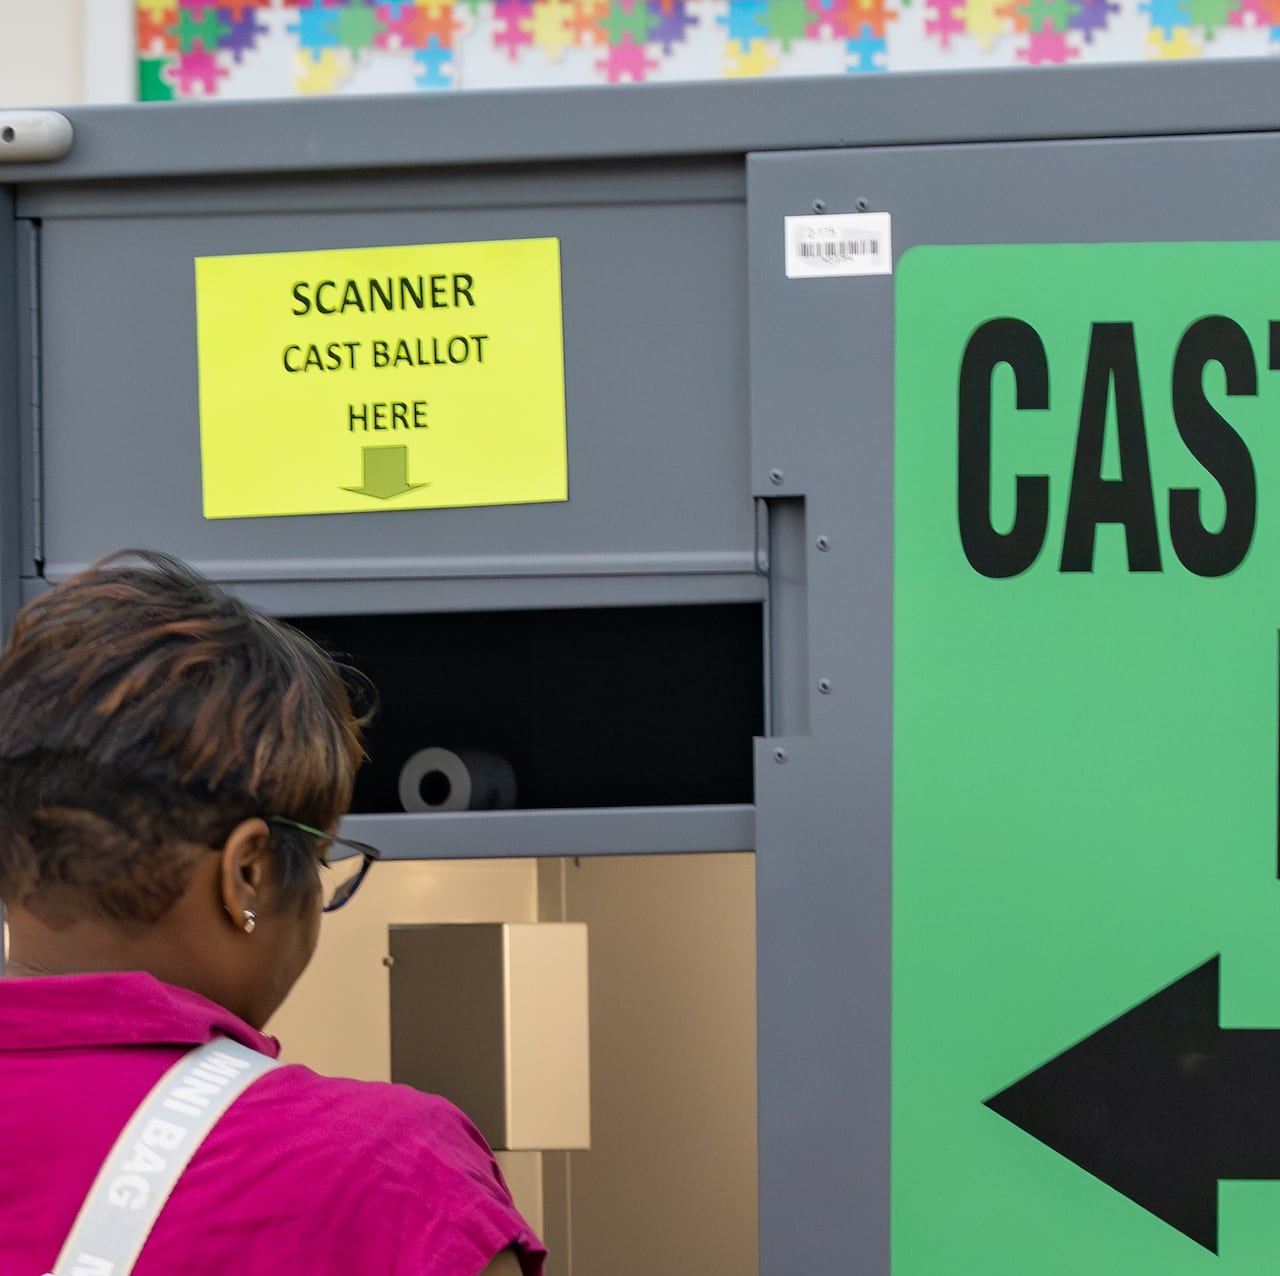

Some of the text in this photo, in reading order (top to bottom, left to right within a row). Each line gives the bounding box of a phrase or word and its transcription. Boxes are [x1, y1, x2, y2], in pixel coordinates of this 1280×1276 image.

[291, 272, 477, 316] SCANNER
[282, 334, 489, 373] CAST BALLOT
[347, 400, 429, 433] HERE
[108, 1051, 252, 1211] MINI BAG
